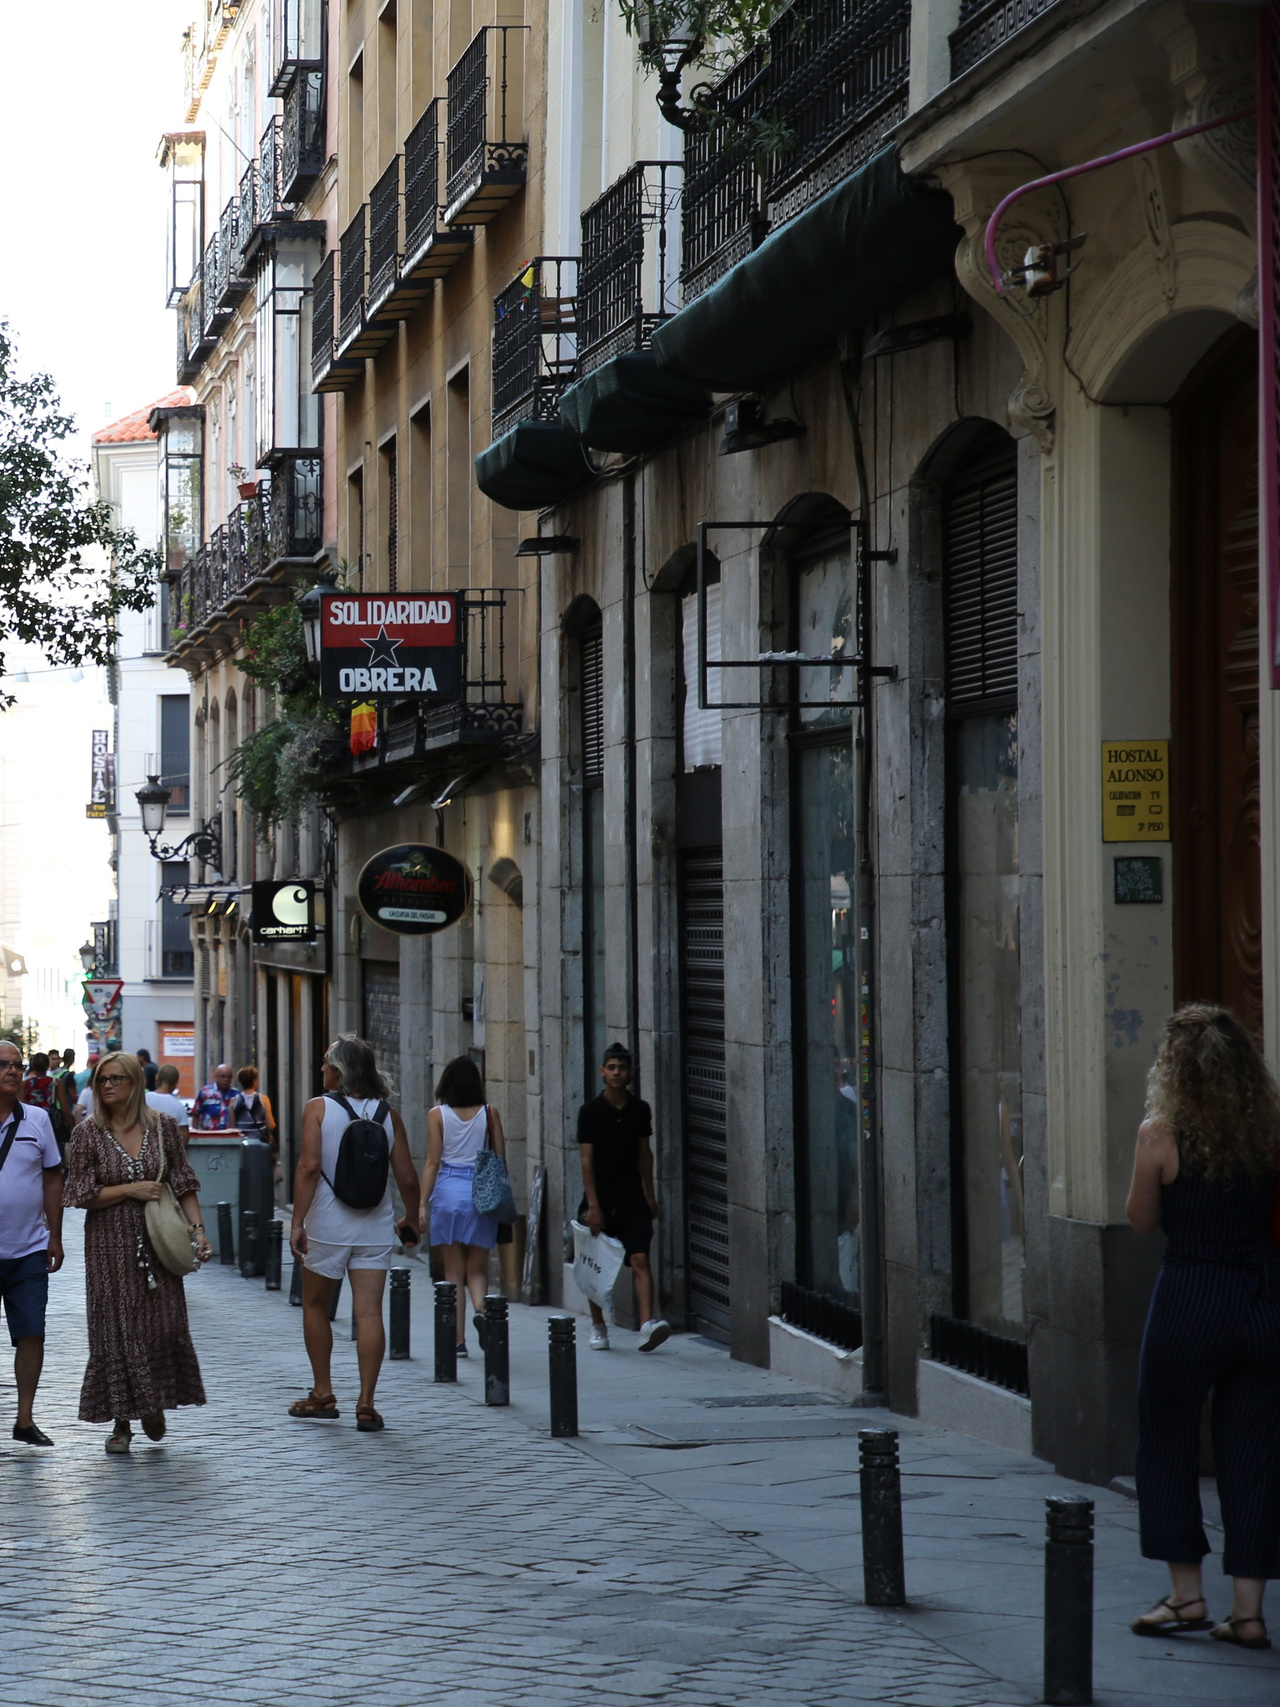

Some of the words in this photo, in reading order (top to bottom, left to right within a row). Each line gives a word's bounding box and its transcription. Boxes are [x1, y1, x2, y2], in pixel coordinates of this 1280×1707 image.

[329, 600, 452, 625] SOLIDARIDAD
[339, 667, 438, 692] OBRERA
[1107, 749, 1163, 764] HOSTAL
[93, 731, 107, 803] HOSTAL
[1106, 768, 1164, 783] ALONSO
[1149, 790, 1162, 800] TV
[1147, 822, 1164, 832] PISO
[373, 870, 457, 893] Alhambra
[260, 926, 308, 935] carhartt
